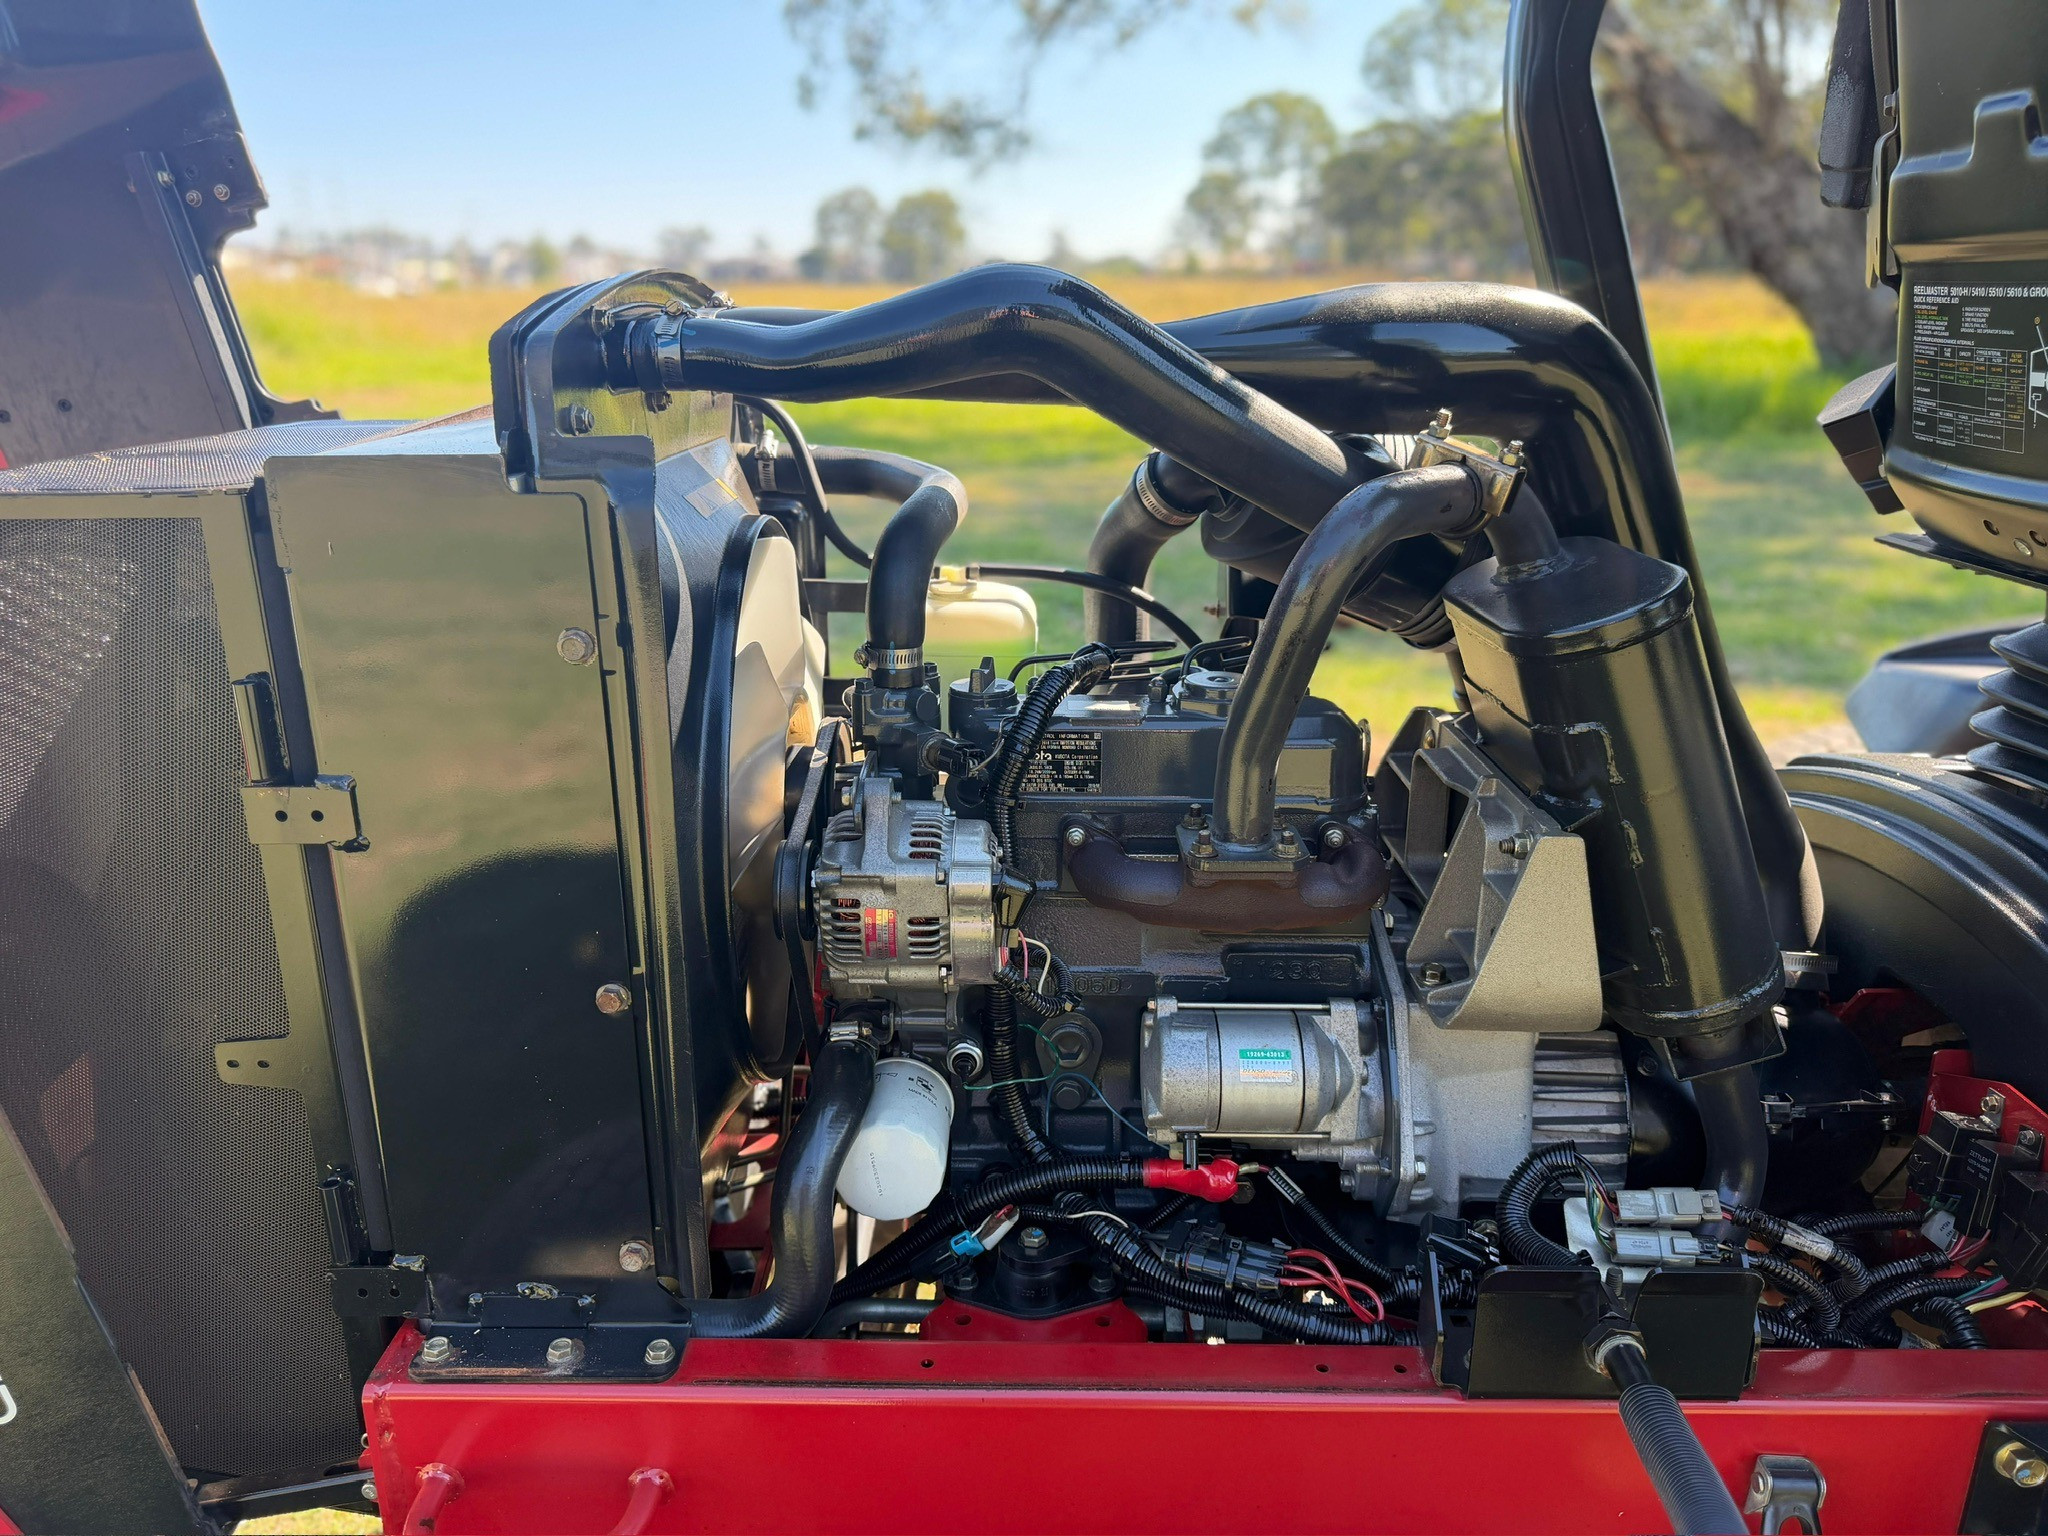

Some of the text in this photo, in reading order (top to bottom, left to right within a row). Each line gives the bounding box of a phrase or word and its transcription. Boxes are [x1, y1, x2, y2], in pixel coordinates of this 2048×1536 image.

[1914, 286, 1949, 296] REELMASTER
[1950, 287, 1968, 296] 5010-H
[1972, 287, 1985, 297] 5410
[1988, 287, 2003, 297] 5510
[2007, 287, 2022, 297] 5610
[2023, 288, 2028, 298] &
